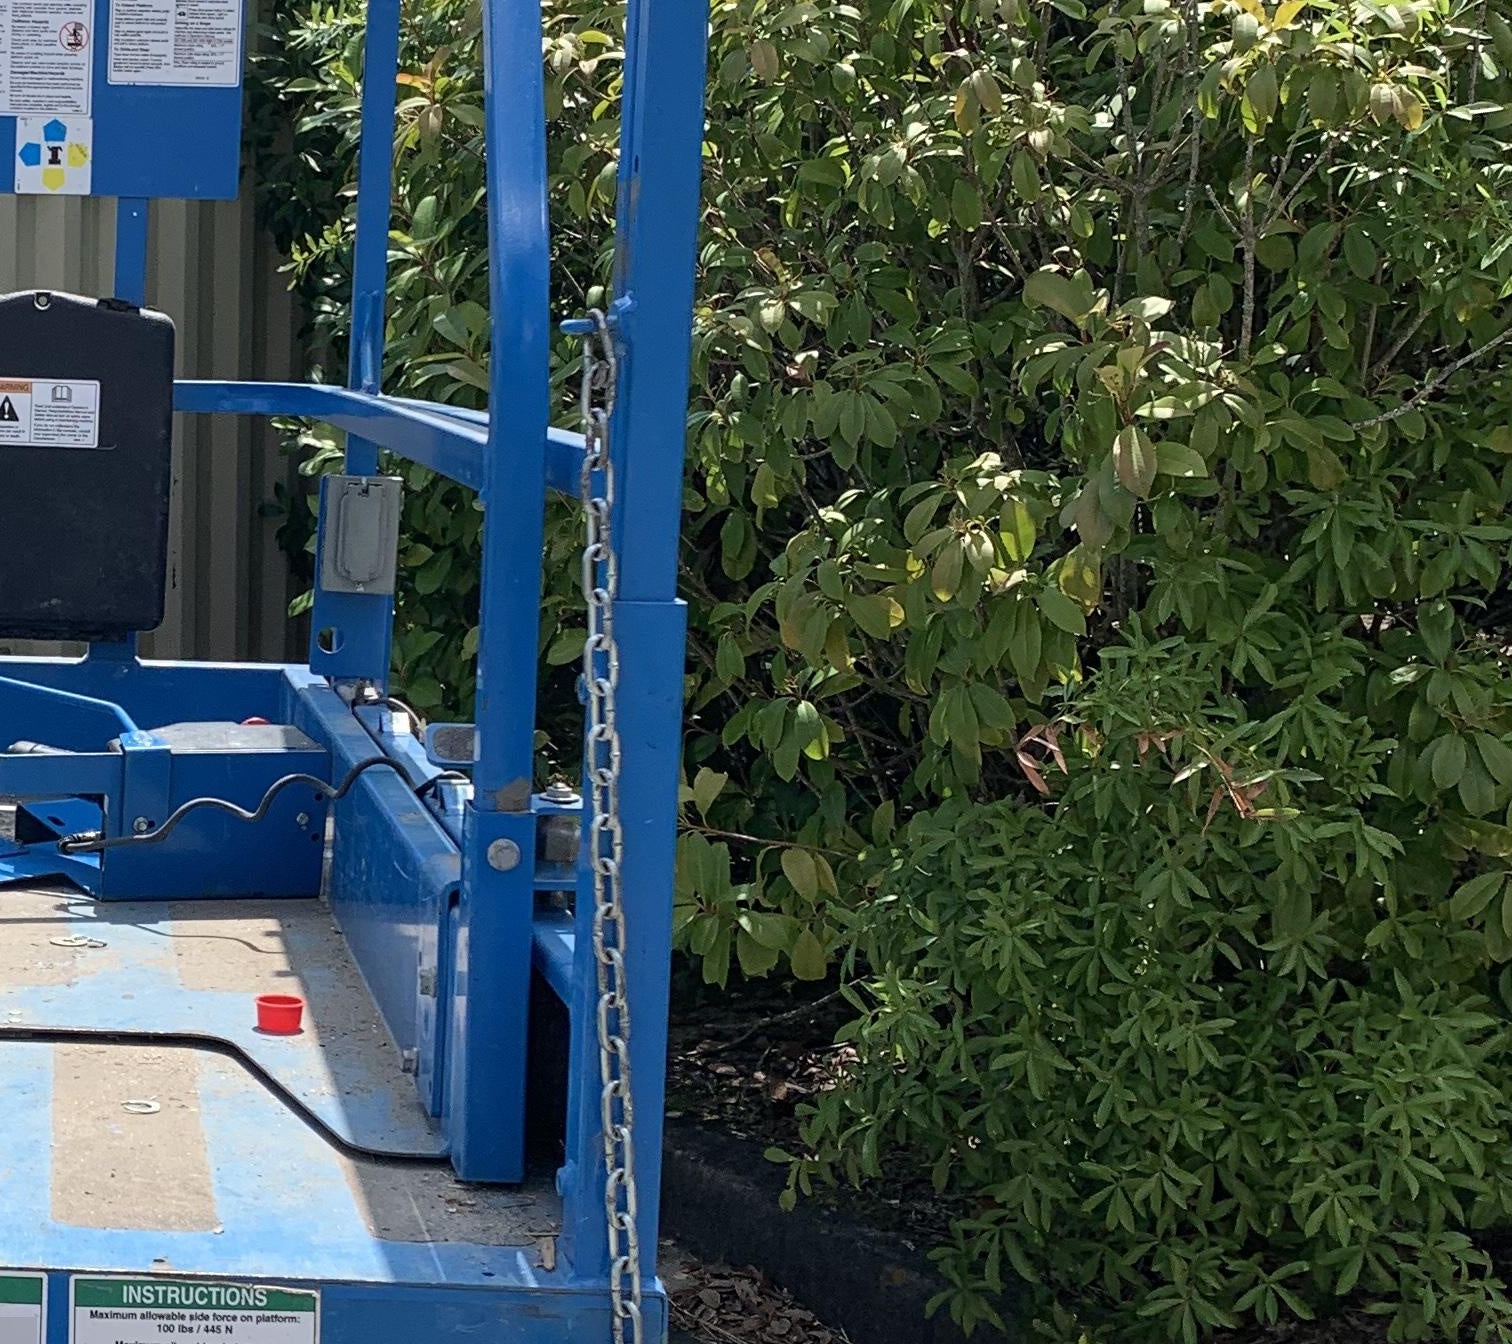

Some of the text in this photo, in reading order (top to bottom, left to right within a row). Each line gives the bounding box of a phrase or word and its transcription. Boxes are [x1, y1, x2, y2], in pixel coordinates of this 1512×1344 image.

[122, 1285, 267, 1307] INSTRUCTIONS
[89, 1310, 137, 1320] Maximum
[140, 1311, 186, 1321] allowable
[189, 1312, 209, 1322] side
[213, 1313, 238, 1322] force
[256, 1314, 301, 1325] platform:
[157, 1324, 175, 1333] 100
[178, 1324, 193, 1333] lbs
[204, 1325, 222, 1333] 445
[225, 1325, 233, 1334] N
